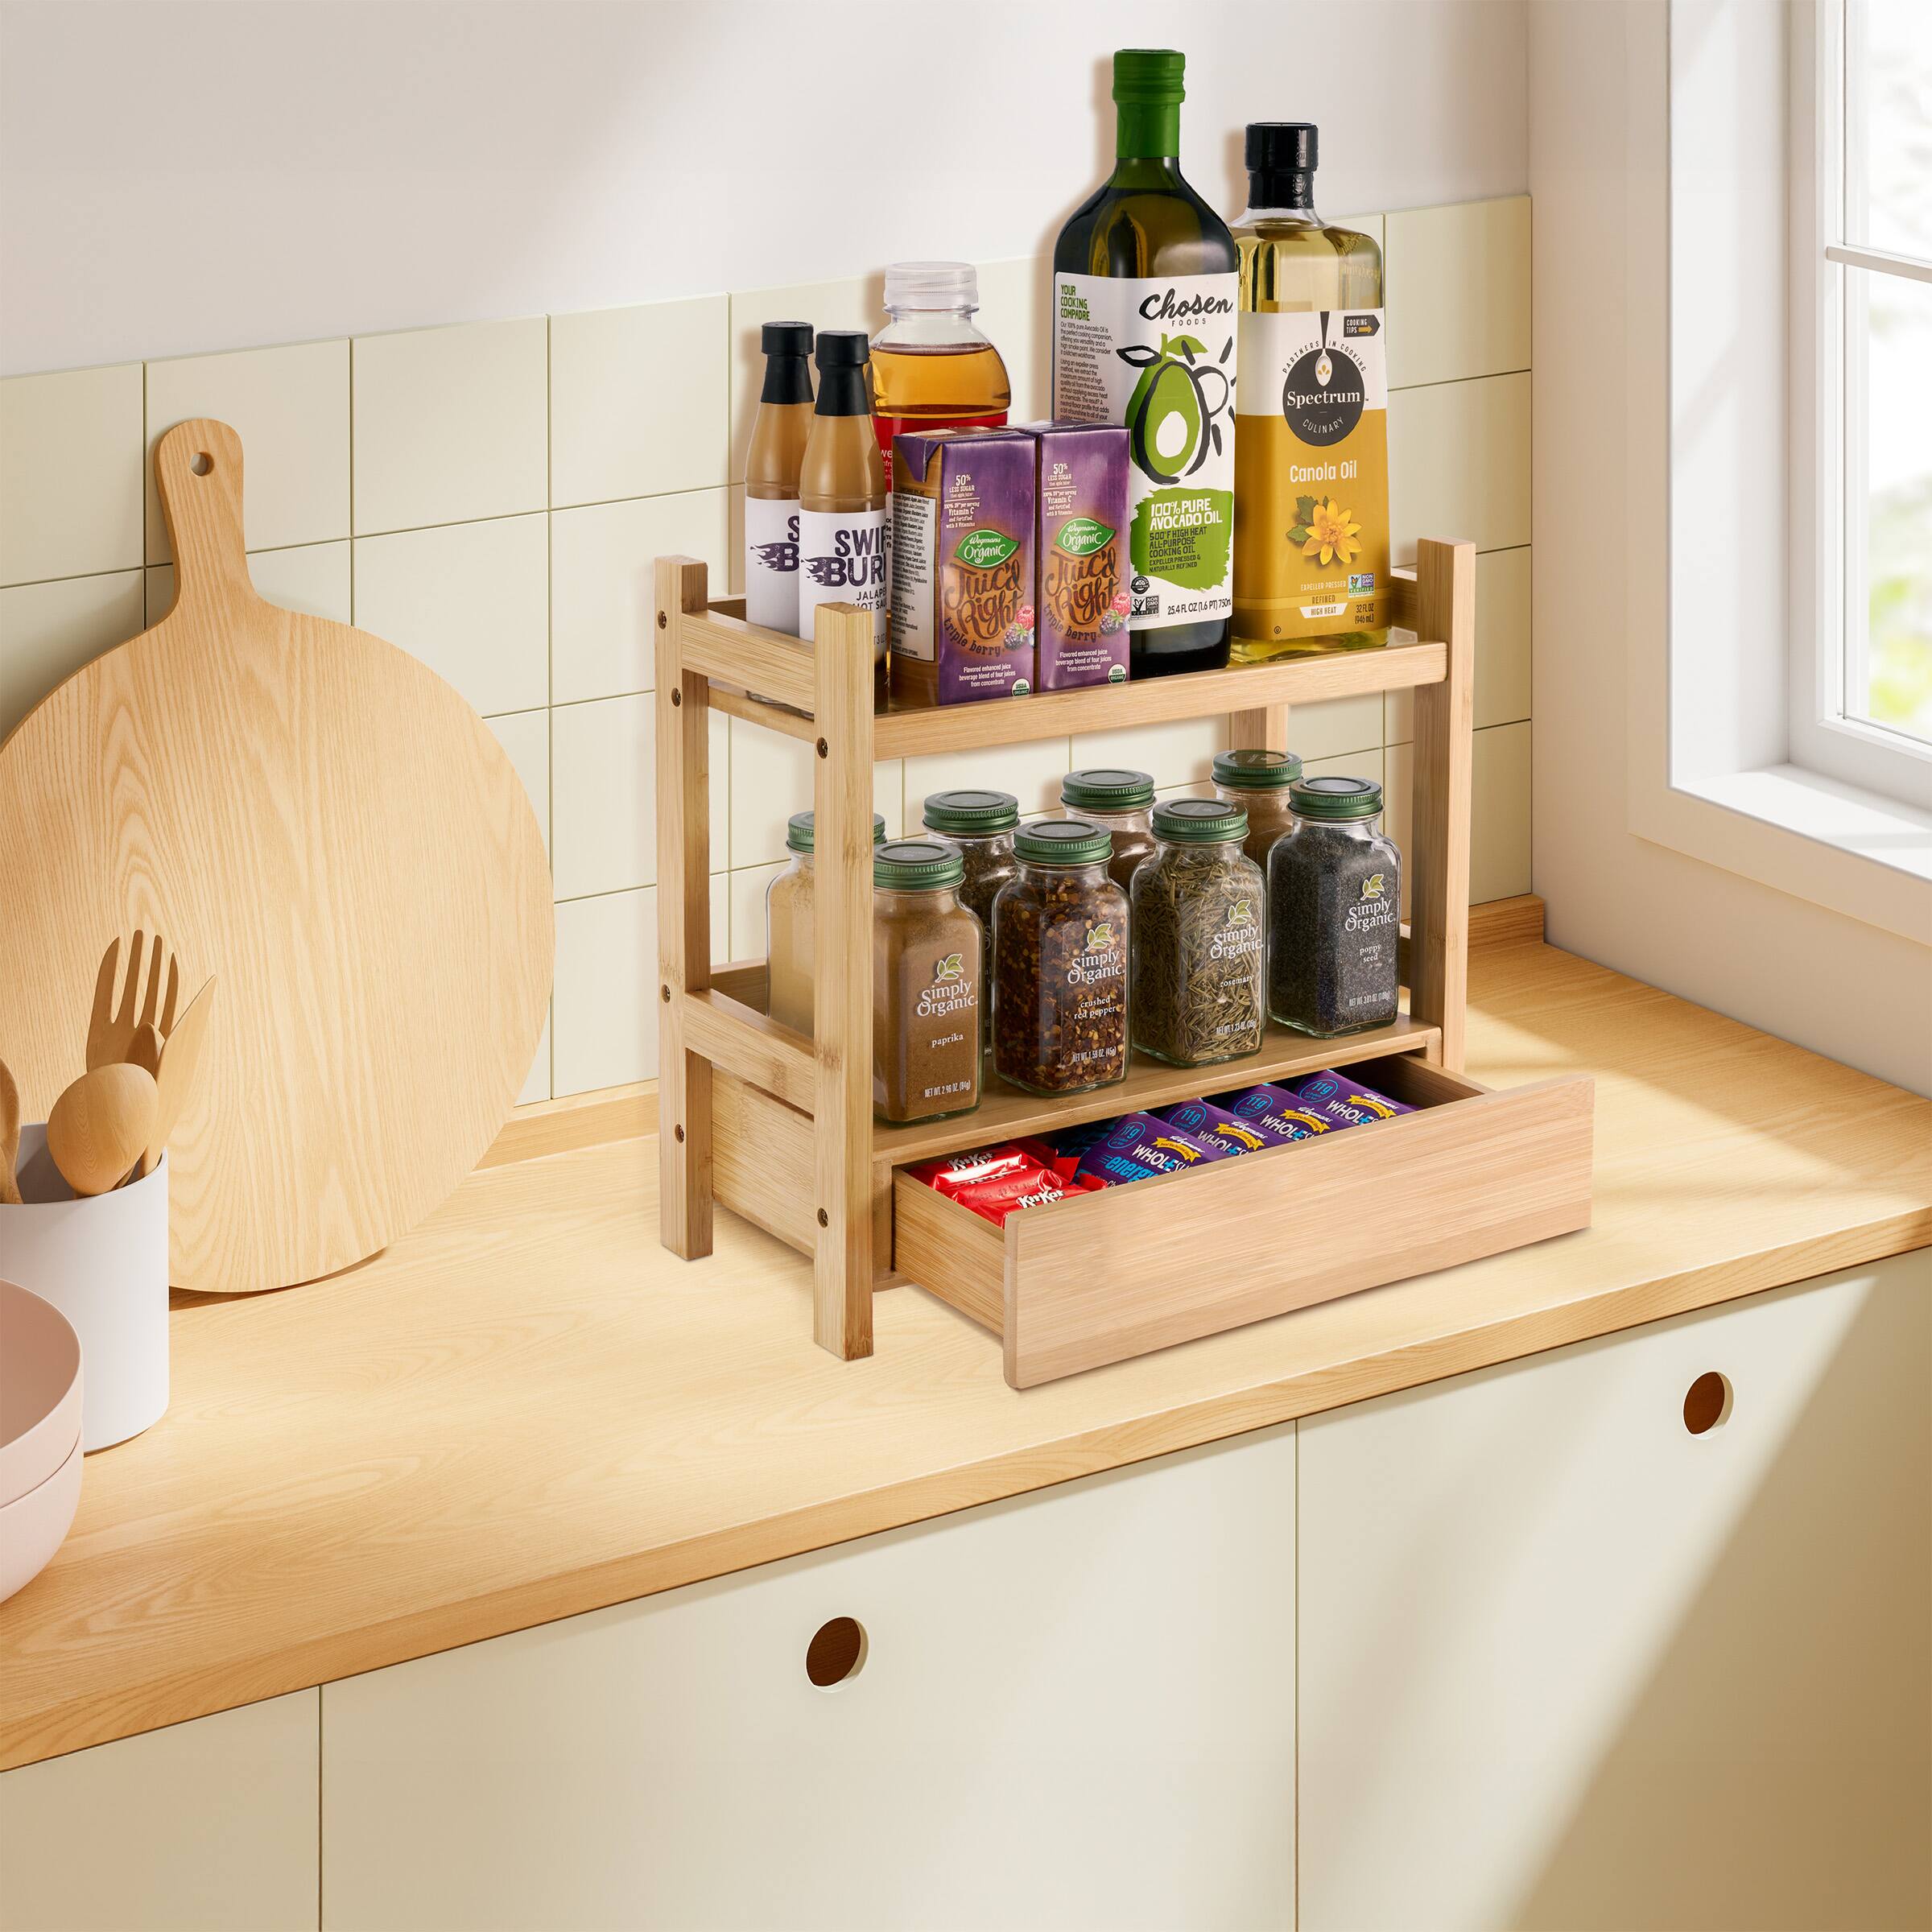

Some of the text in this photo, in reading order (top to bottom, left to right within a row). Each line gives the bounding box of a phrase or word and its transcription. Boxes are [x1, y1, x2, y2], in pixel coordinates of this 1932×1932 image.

[1060, 284, 1075, 295] YOUR
[1060, 296, 1088, 310] COOKING
[1139, 288, 1232, 320] Chosen
[1060, 308, 1090, 321] COMPADRE
[1171, 318, 1207, 327] FOODS
[1282, 341, 1319, 374] PARTNERS
[1340, 344, 1366, 372] COOKING
[1287, 390, 1360, 409] Spectrum
[1302, 416, 1344, 434] CULINARY
[1053, 463, 1068, 475] 50%
[1290, 460, 1357, 482] Canola Oil
[956, 474, 972, 486] 50%
[1151, 497, 1212, 517] 100% PURE
[1150, 510, 1223, 530] AVOCADO OIL
[1067, 522, 1098, 535] Wegmans
[1172, 528, 1189, 538] HIGH
[1191, 526, 1208, 536] HEAT
[969, 535, 1001, 547] Wegmans
[1063, 532, 1102, 551] Organic
[1150, 537, 1195, 549] ALL-PURPOSE
[964, 544, 1005, 563] Organic
[1149, 545, 1195, 558] COOKING OIL
[1149, 556, 1174, 566] EXPELLER
[1174, 555, 1195, 564] PRESSED
[1149, 561, 1197, 573] NATURALLY REFINED
[1045, 547, 1121, 597] Juic'd
[944, 559, 1025, 610] Juic'd
[1301, 580, 1347, 592] EXPELLER PRESSED
[1055, 577, 1121, 625] Right
[1312, 595, 1335, 604] REFINED
[956, 588, 1025, 640] Right
[1167, 605, 1180, 615] 25.4
[1181, 604, 1187, 613] FL
[1188, 603, 1197, 612] OZ
[1209, 600, 1218, 611] PT)
[1311, 606, 1337, 616] HIGH HEAT
[1356, 603, 1374, 613] 32 FL OZ
[944, 616, 968, 646] triple
[969, 640, 1001, 658] berry
[1065, 625, 1097, 643] berry
[1078, 649, 1097, 657] enhanced
[980, 679, 1005, 687] concentrate
[1349, 898, 1392, 919] Simply
[1214, 923, 1259, 946] Simply
[1360, 943, 1381, 956] poppy
[1071, 948, 1120, 970] Simply
[1363, 953, 1378, 963] seed
[1220, 975, 1254, 987] rosemary
[922, 979, 972, 1003] Simply
[1080, 995, 1110, 1008] crushed
[1074, 1006, 1116, 1019] red pepper
[932, 1033, 964, 1047] paprika
[925, 1088, 933, 1098] NET
[1312, 1082, 1333, 1095] 11g
[1246, 1096, 1268, 1110] 11g
[1181, 1108, 1202, 1125] 11g
